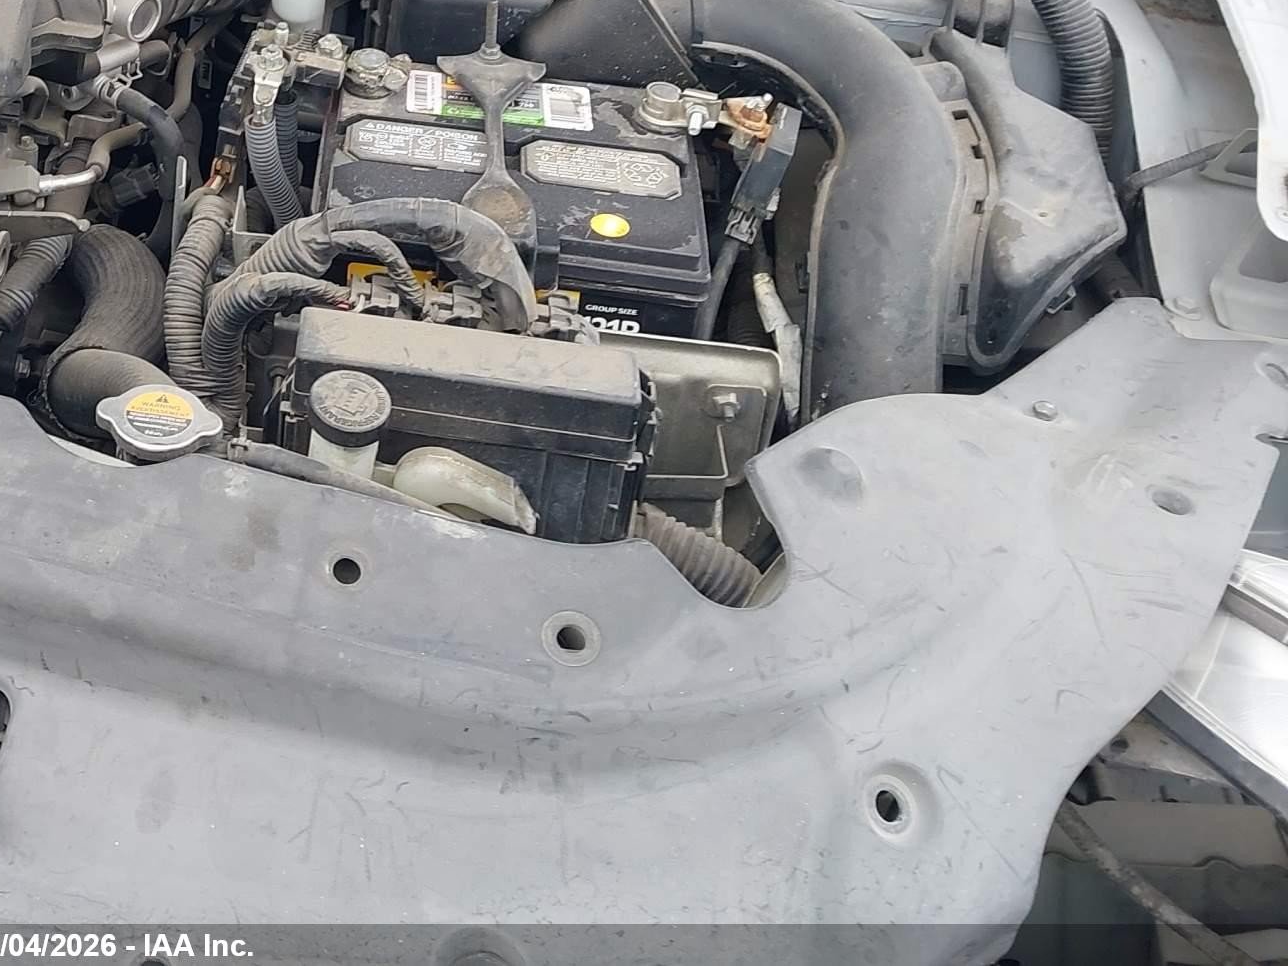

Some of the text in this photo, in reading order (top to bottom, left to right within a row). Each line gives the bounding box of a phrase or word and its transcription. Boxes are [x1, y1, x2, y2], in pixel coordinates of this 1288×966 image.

[376, 123, 424, 134] DANGER
[435, 130, 478, 141] POISON
[585, 304, 639, 316] GROUP SIZE
[142, 400, 181, 411] WARNING
